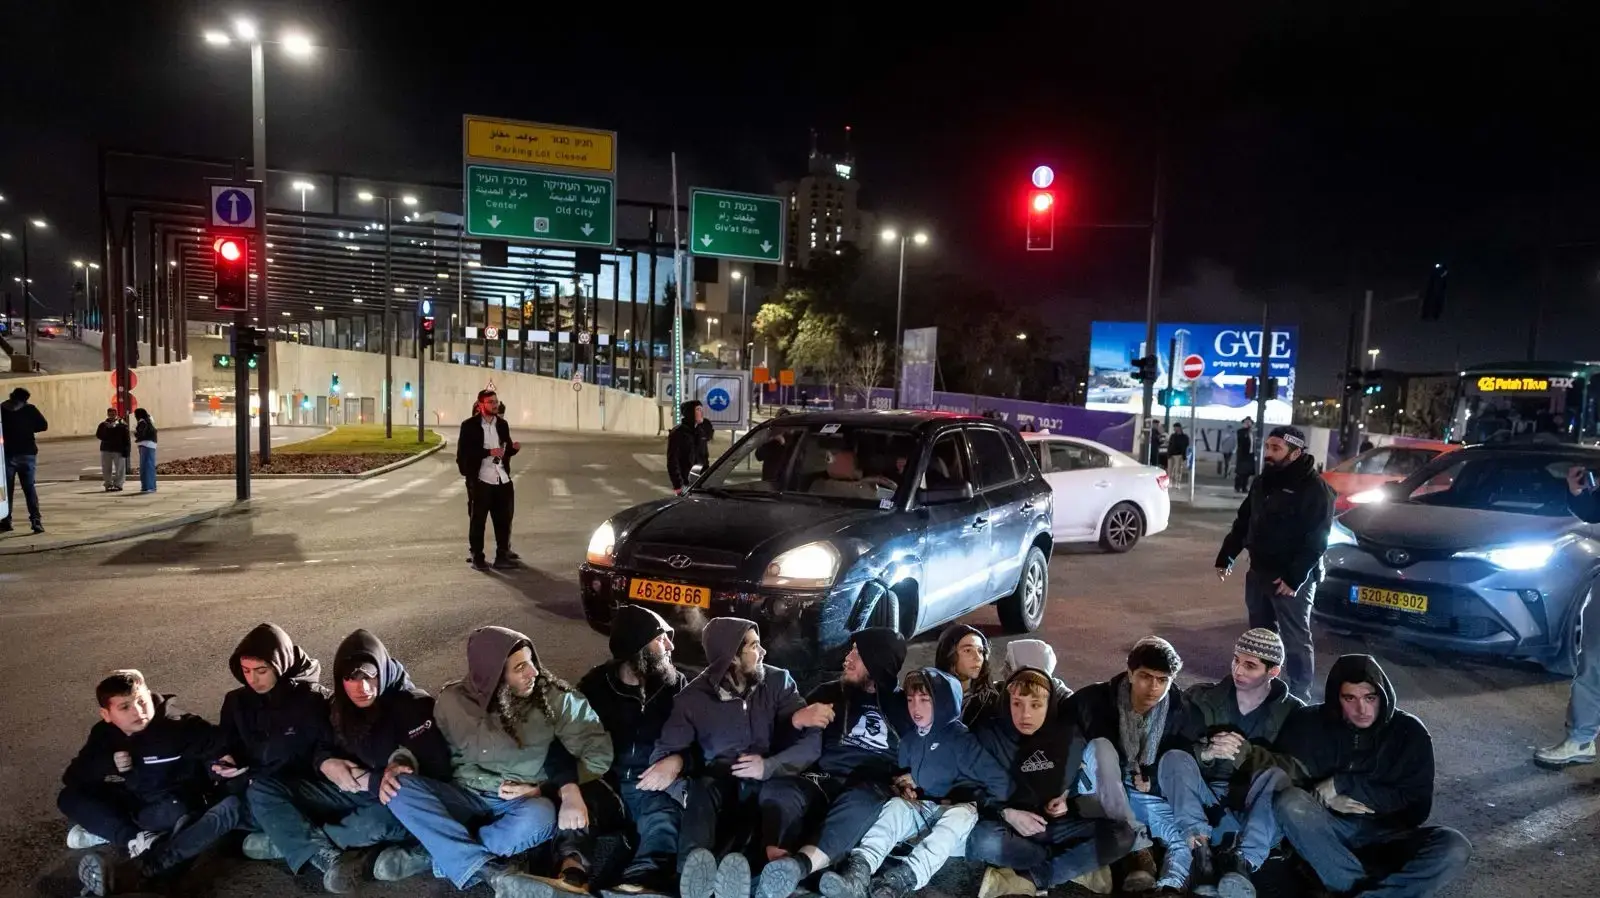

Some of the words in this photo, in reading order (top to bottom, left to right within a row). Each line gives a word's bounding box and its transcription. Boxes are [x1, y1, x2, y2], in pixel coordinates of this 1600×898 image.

[495, 145, 532, 157] Parking
[536, 149, 550, 158] Lot
[555, 150, 588, 161] Closed
[476, 173, 499, 183] העיר
[503, 176, 528, 186] מרכז
[476, 185, 503, 195] المدينة
[543, 180, 581, 192] העתיקה
[584, 184, 606, 194] העיר
[508, 189, 528, 200] مركز
[485, 199, 518, 210] Center
[719, 200, 731, 209] רם
[734, 202, 758, 212] גבעת
[555, 206, 571, 215] Old
[575, 207, 594, 218] City
[714, 223, 740, 233] Giv'at
[742, 226, 760, 235] Ram
[1214, 330, 1291, 359] GATE
[1522, 378, 1547, 390] Tikva
[1021, 761, 1055, 772] adidas
